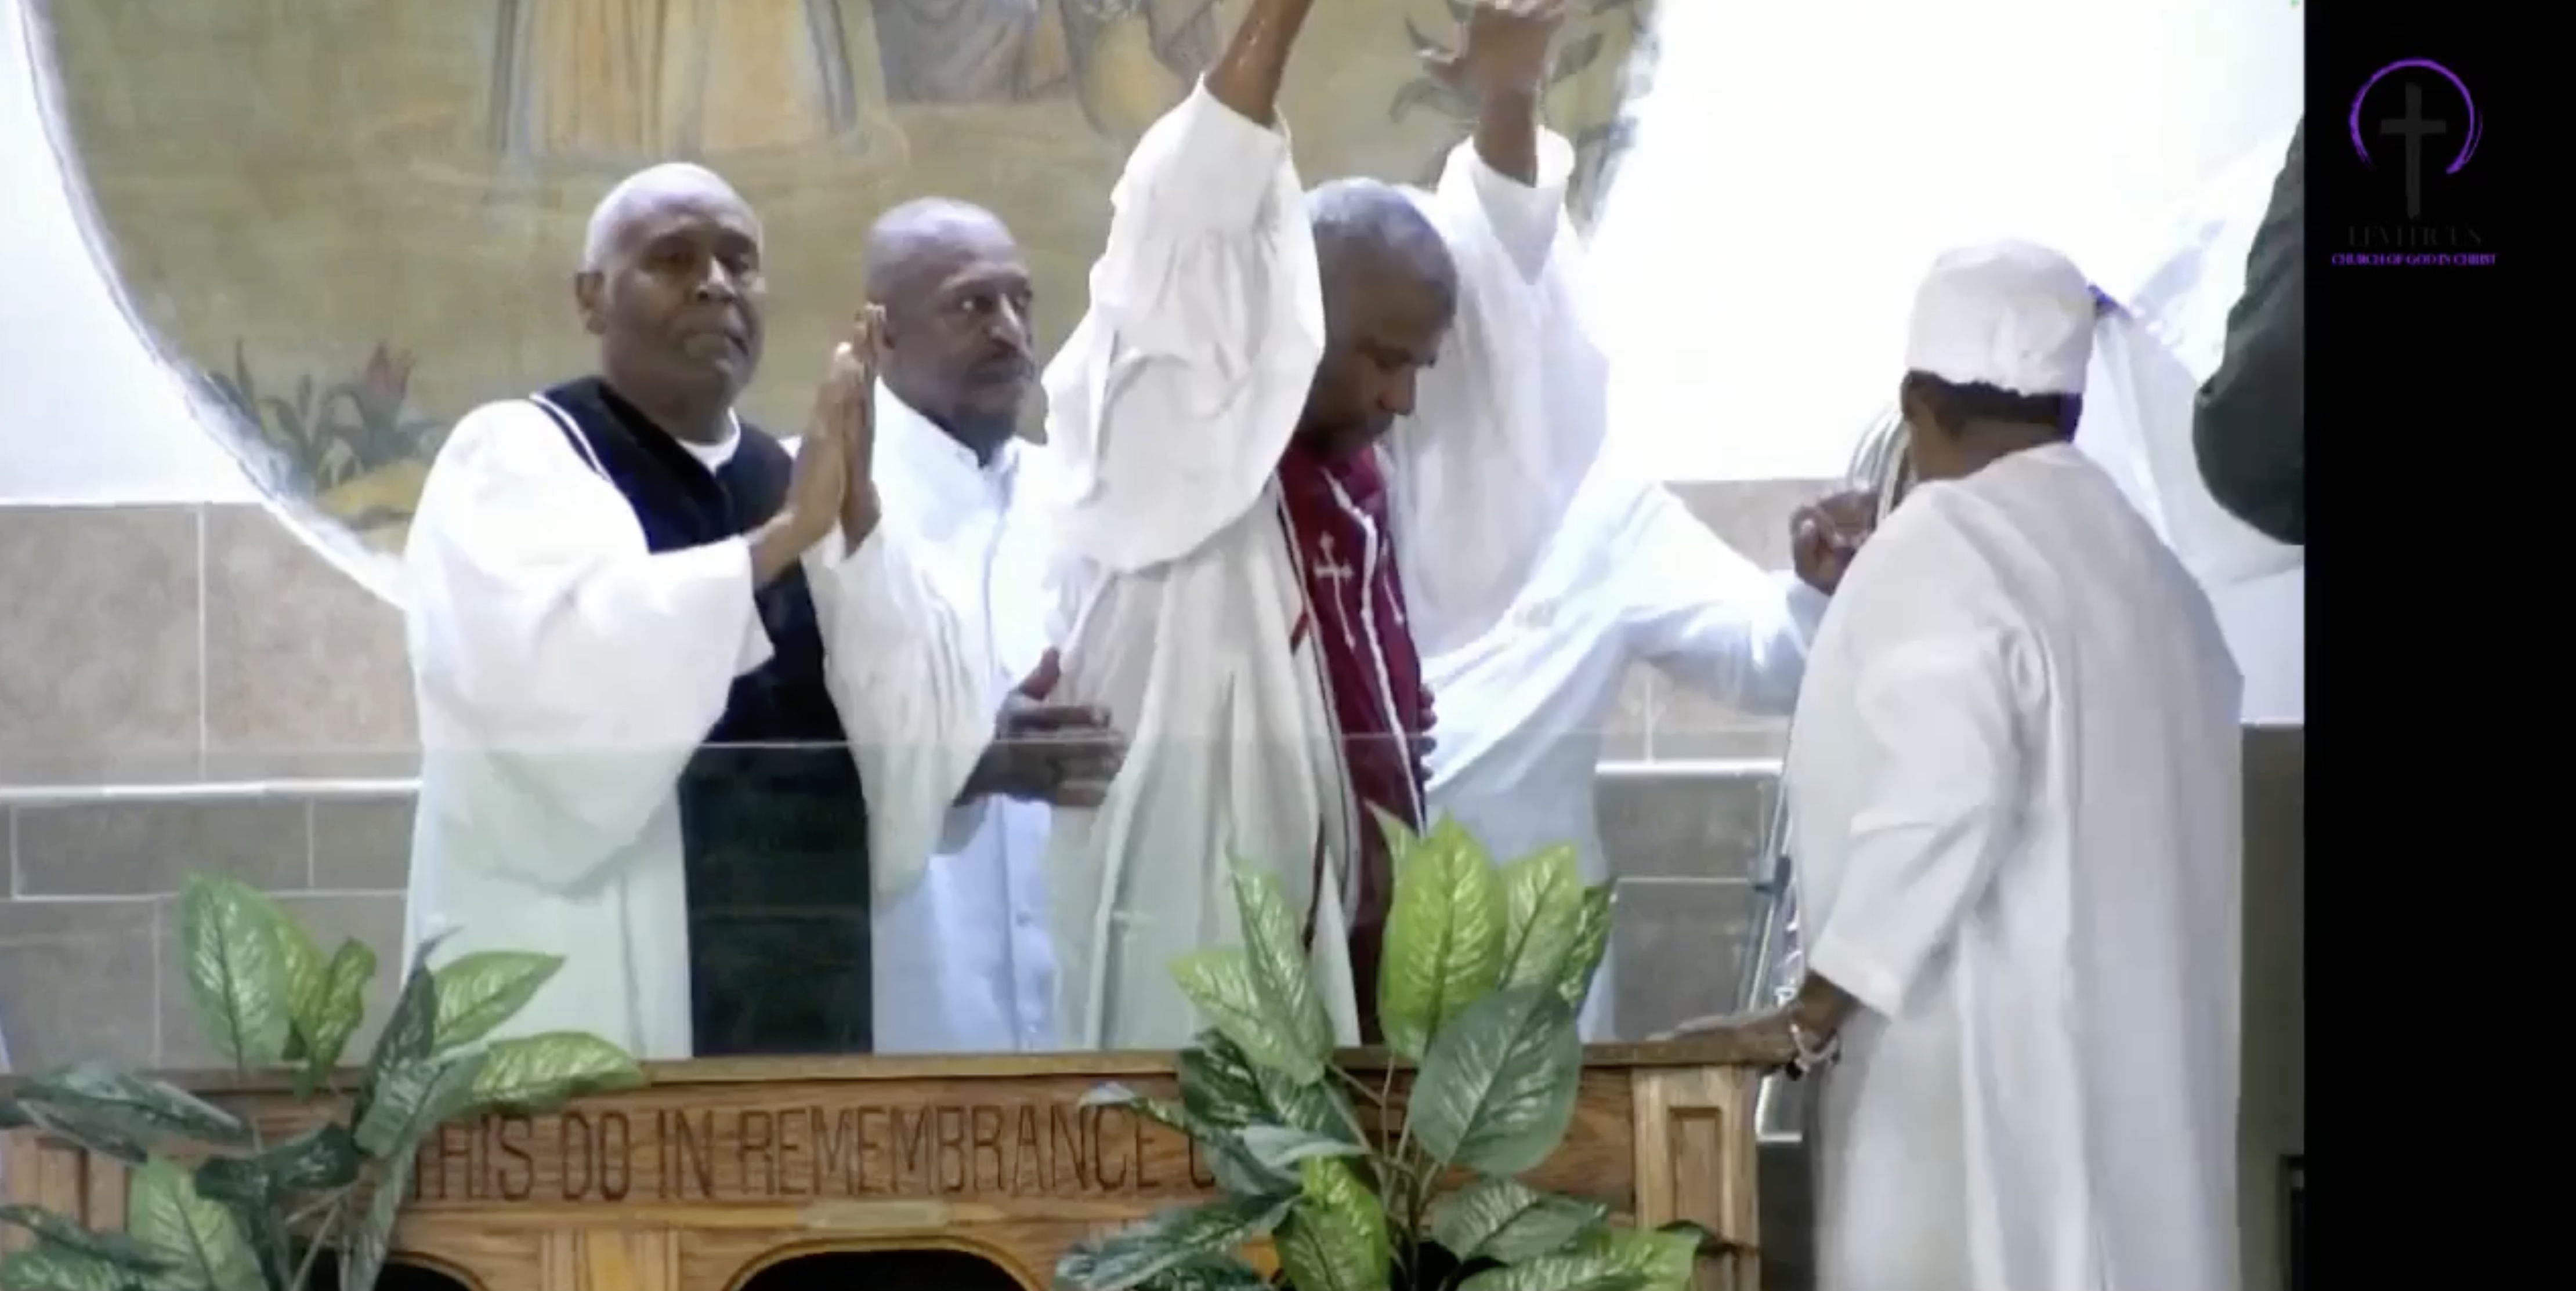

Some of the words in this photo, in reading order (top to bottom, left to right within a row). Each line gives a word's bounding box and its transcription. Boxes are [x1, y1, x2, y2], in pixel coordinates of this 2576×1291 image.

[560, 1110, 631, 1202] DO
[657, 1108, 714, 1200] IN
[739, 1104, 1162, 1195] REMEMBRANCE
